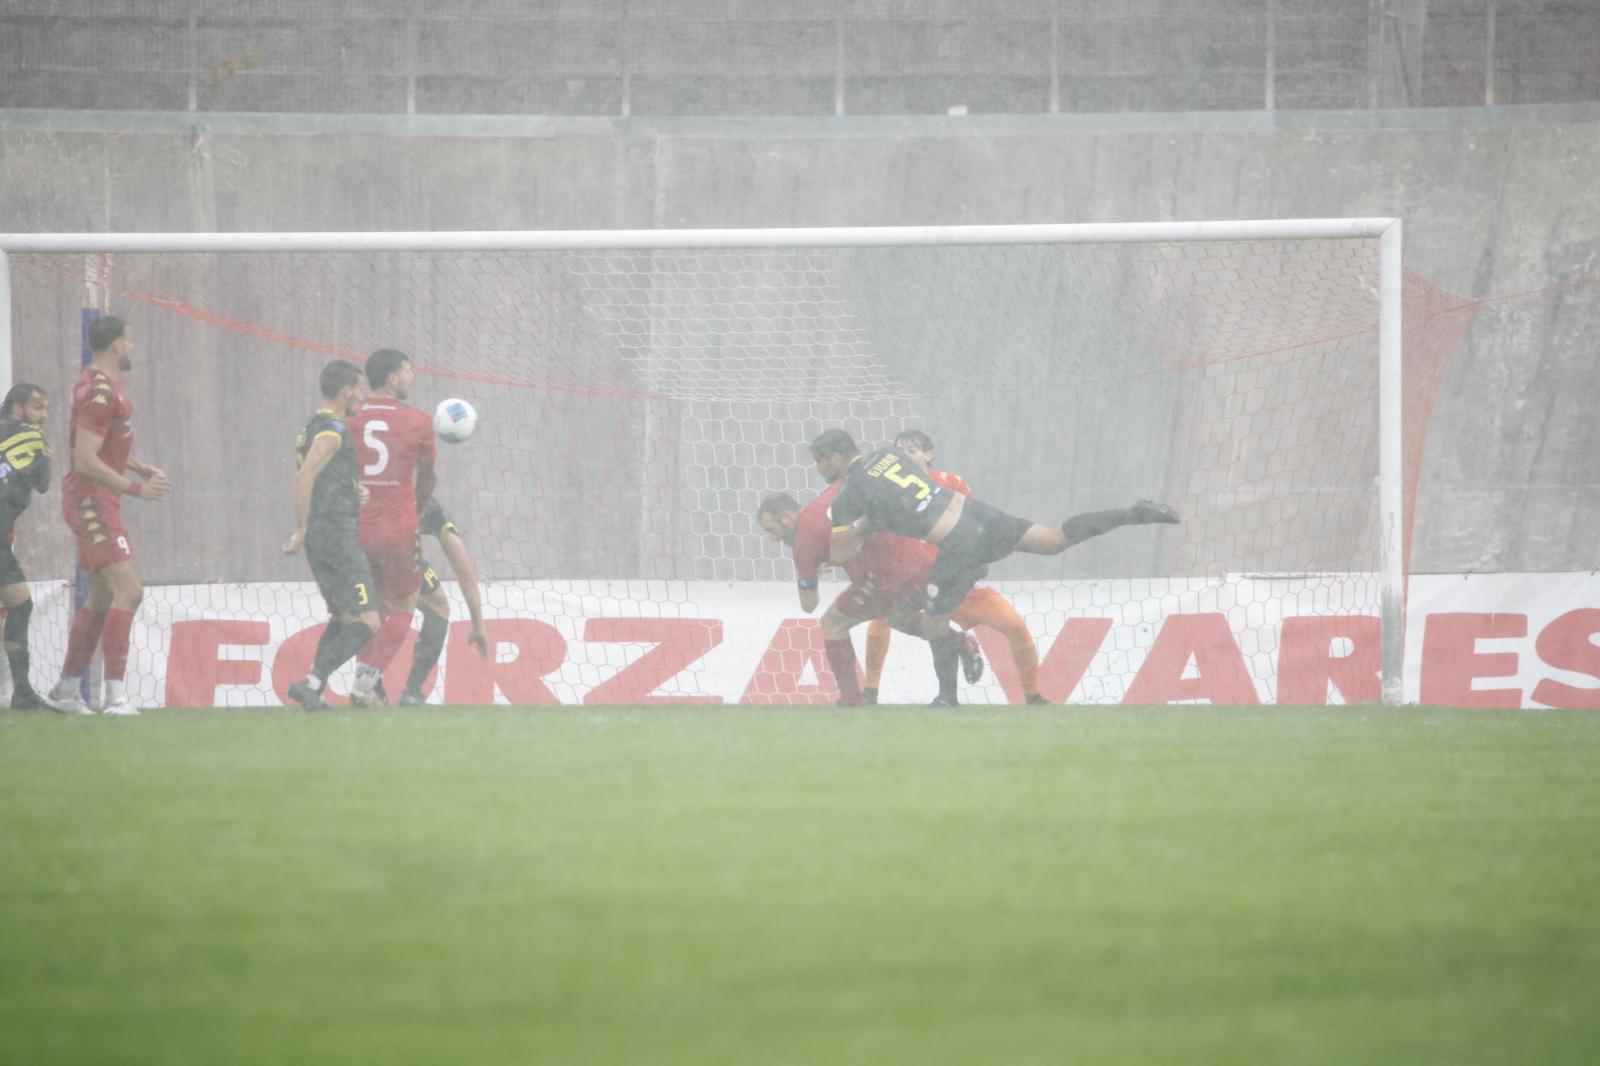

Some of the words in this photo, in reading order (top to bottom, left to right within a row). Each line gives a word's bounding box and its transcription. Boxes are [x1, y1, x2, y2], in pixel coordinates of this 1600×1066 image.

[363, 419, 390, 476] 5
[883, 463, 931, 500] 5
[116, 535, 131, 555] 9
[354, 583, 369, 606] 3
[165, 617, 868, 707] FORZA
